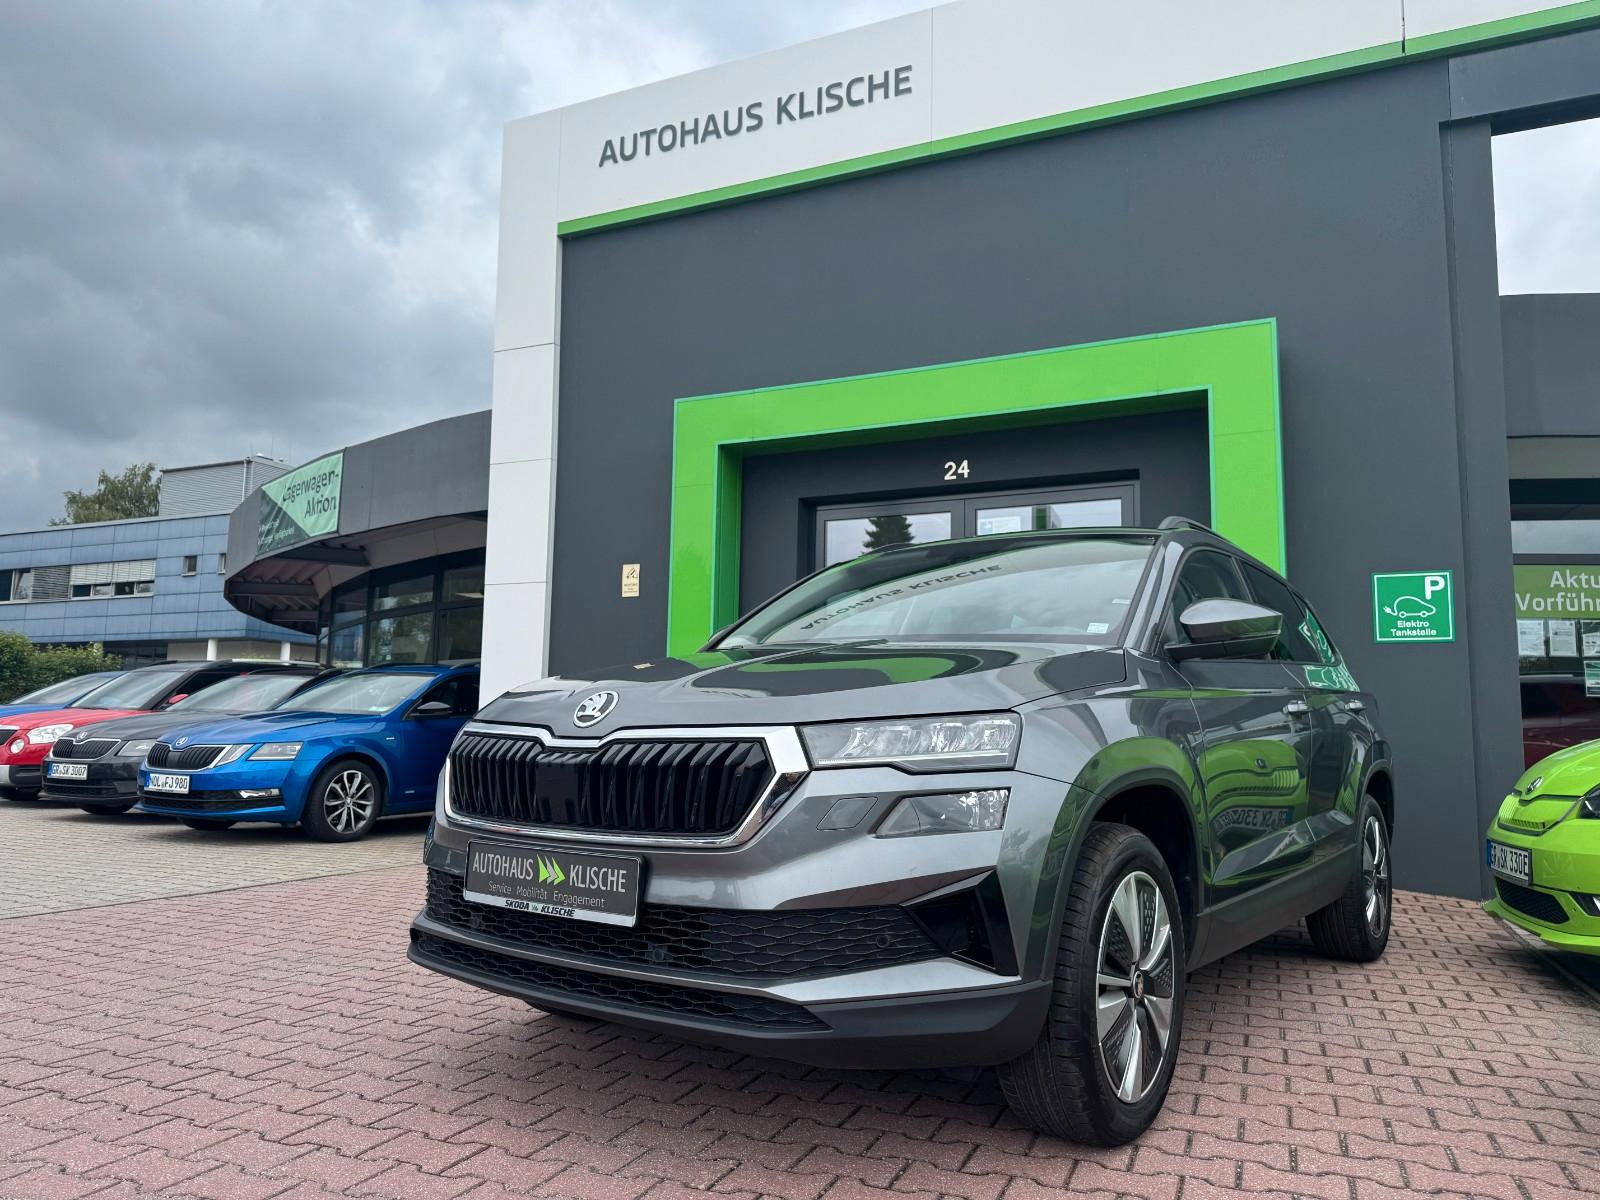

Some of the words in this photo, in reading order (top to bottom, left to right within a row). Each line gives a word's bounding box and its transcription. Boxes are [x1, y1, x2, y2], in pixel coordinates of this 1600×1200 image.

[598, 101, 763, 168] AUTOHAUS
[777, 64, 913, 125] KLISCHE
[944, 459, 970, 481] 24
[282, 469, 339, 503] Lagerwagen-
[304, 494, 337, 518] Aktion
[1424, 575, 1446, 600] P
[1550, 569, 1600, 588] Aktu
[1391, 628, 1437, 636] Tankstelle
[1397, 620, 1430, 628] Elektro
[165, 776, 174, 788] FJ
[472, 851, 534, 881] AUTOHAUS
[569, 864, 627, 893] KLISCHE
[1501, 847, 1508, 870] SK
[1510, 850, 1529, 876] 330E
[488, 881, 512, 895] Service
[516, 886, 548, 901] Mobilität
[553, 890, 606, 908] Engagement
[540, 905, 576, 917] KLISCHE
